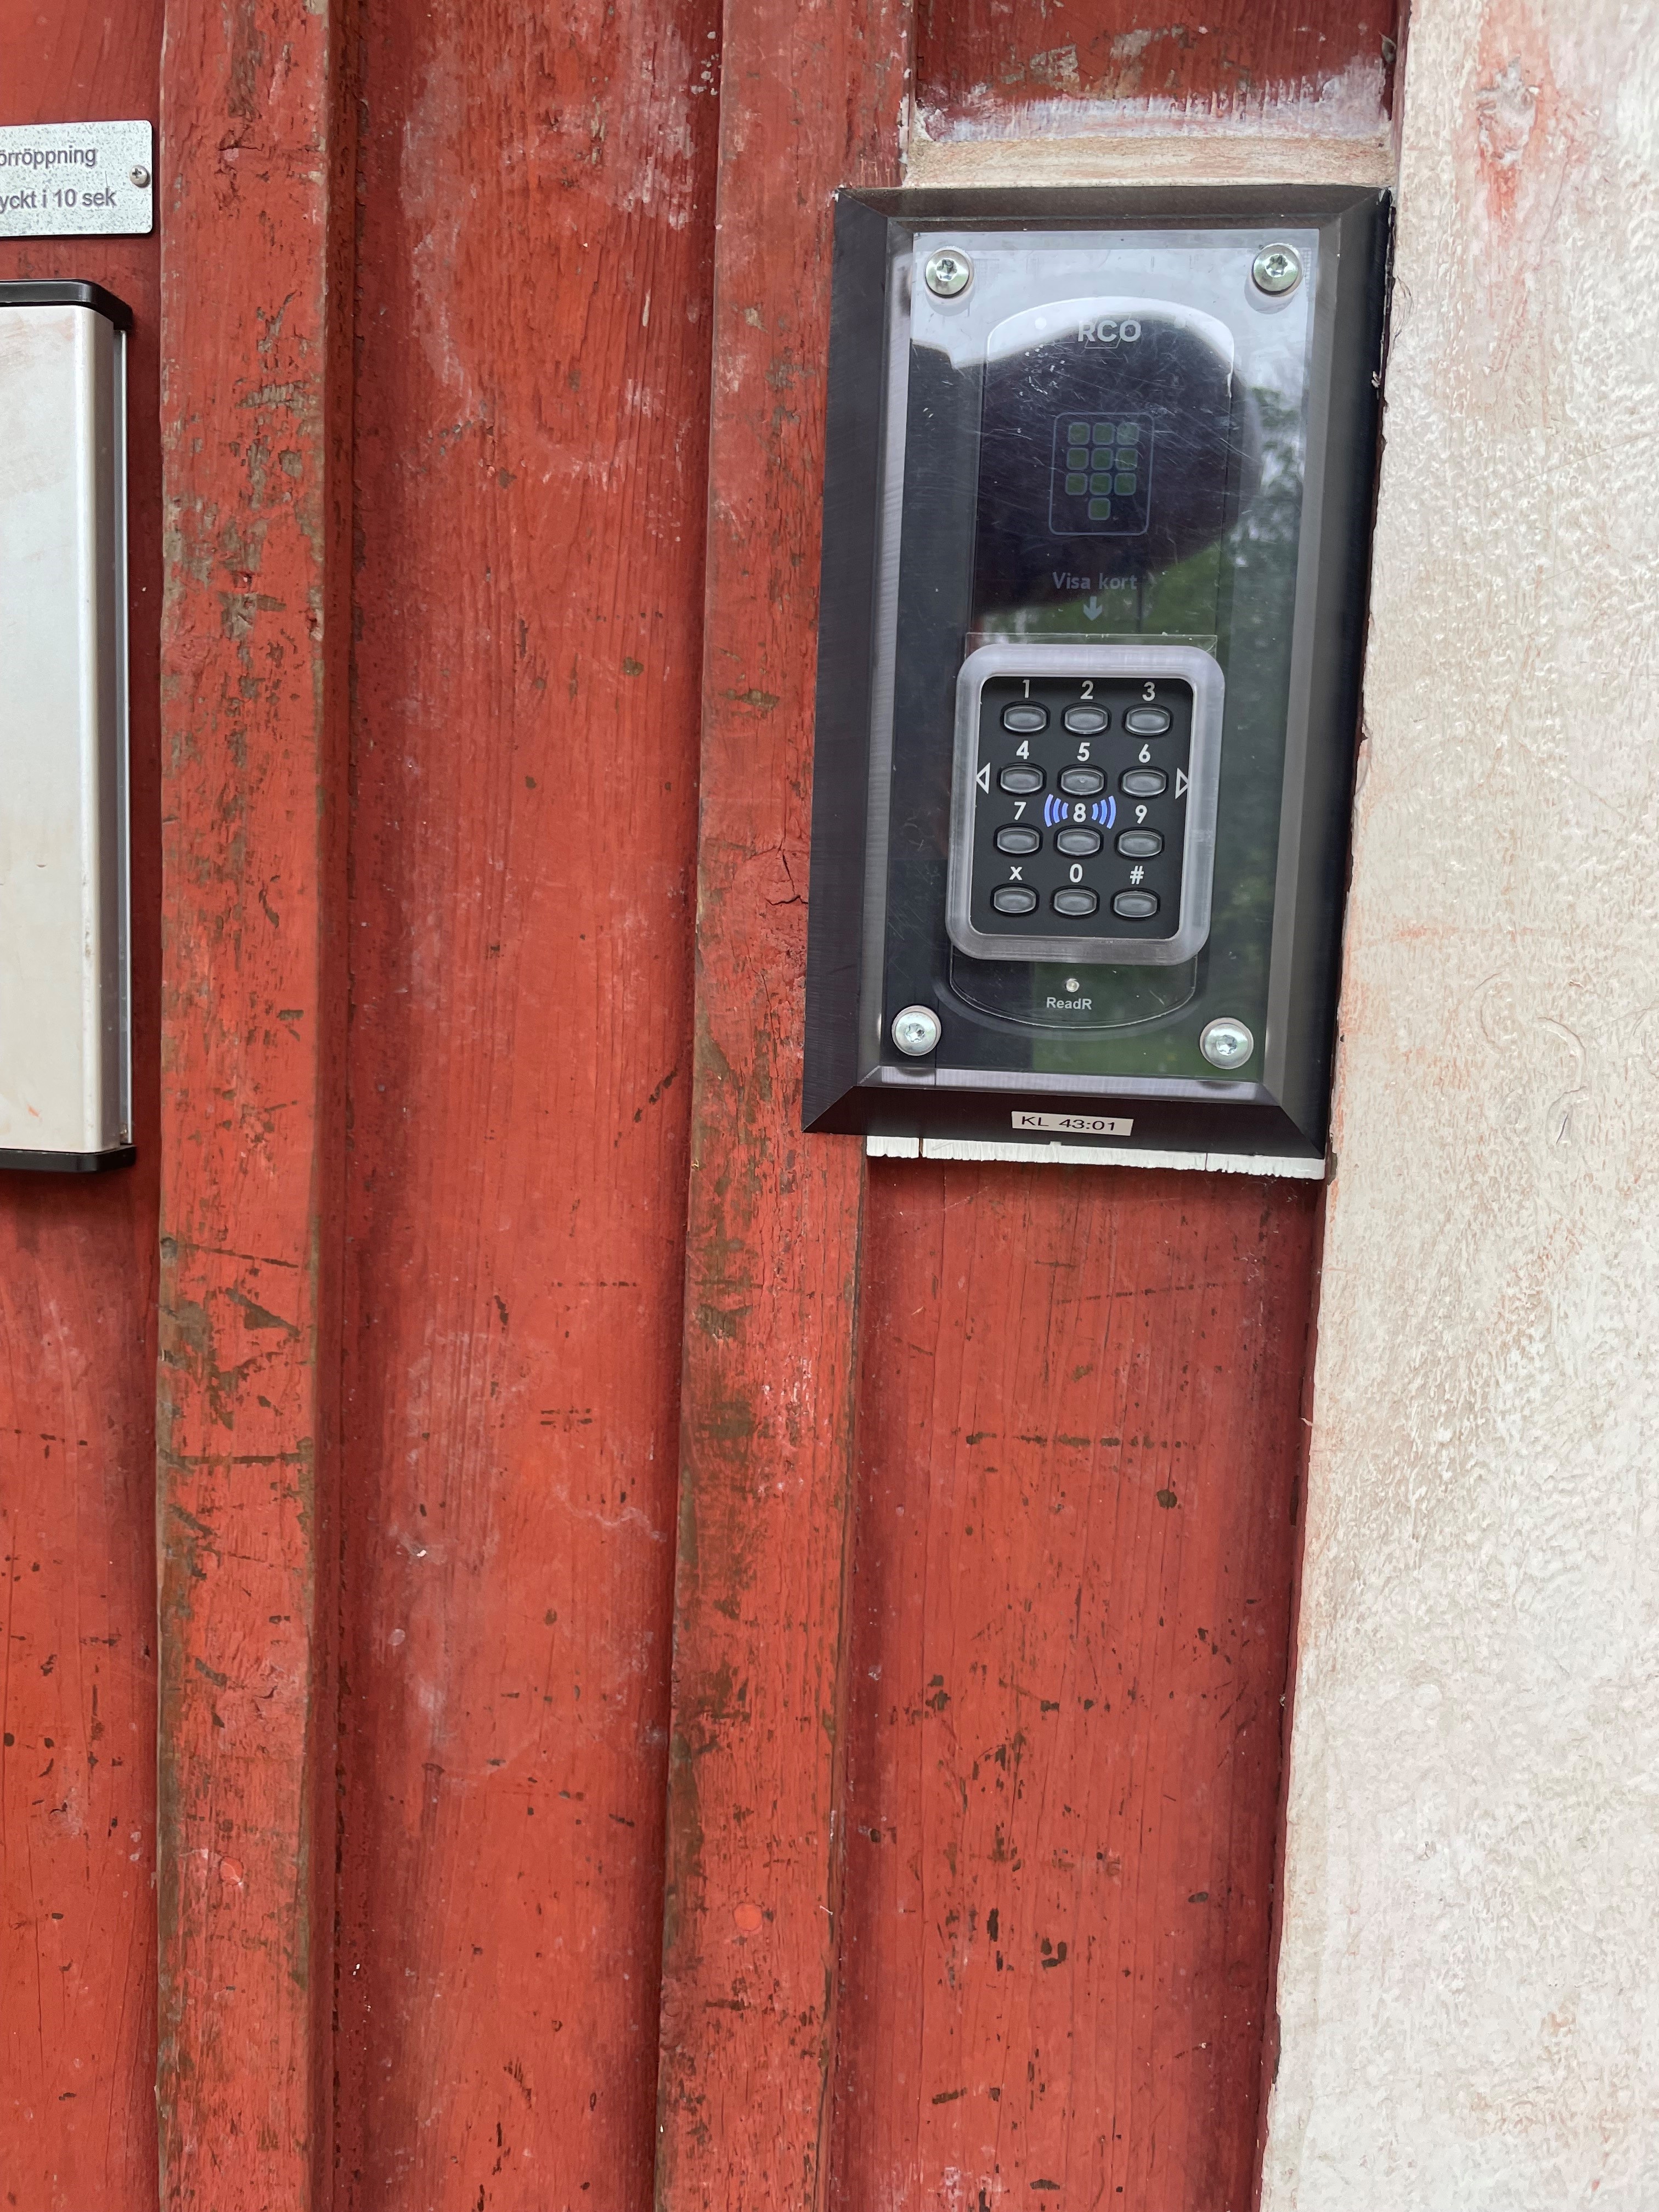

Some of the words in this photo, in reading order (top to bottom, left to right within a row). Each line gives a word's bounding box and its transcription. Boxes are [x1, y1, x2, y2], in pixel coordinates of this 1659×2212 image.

[42, 189, 47, 208] i
[54, 189, 76, 207] 10
[82, 188, 116, 207] sek
[1077, 320, 1141, 342] RCO
[1052, 572, 1091, 590] Visa
[1099, 573, 1137, 590] kort
[1022, 680, 1030, 698] 1
[1080, 680, 1093, 699] 2
[1142, 682, 1155, 701] 3
[1016, 740, 1029, 759] 4
[1077, 742, 1090, 761] 5
[1138, 743, 1151, 763] 6
[1014, 802, 1026, 821] 7
[1073, 803, 1086, 822] 8
[1135, 805, 1148, 824] 9
[1070, 864, 1082, 883] 0
[1130, 865, 1144, 884] #
[1046, 996, 1092, 1010] ReadR
[1021, 1116, 1048, 1127] KL
[1058, 1118, 1116, 1131] 43:01
